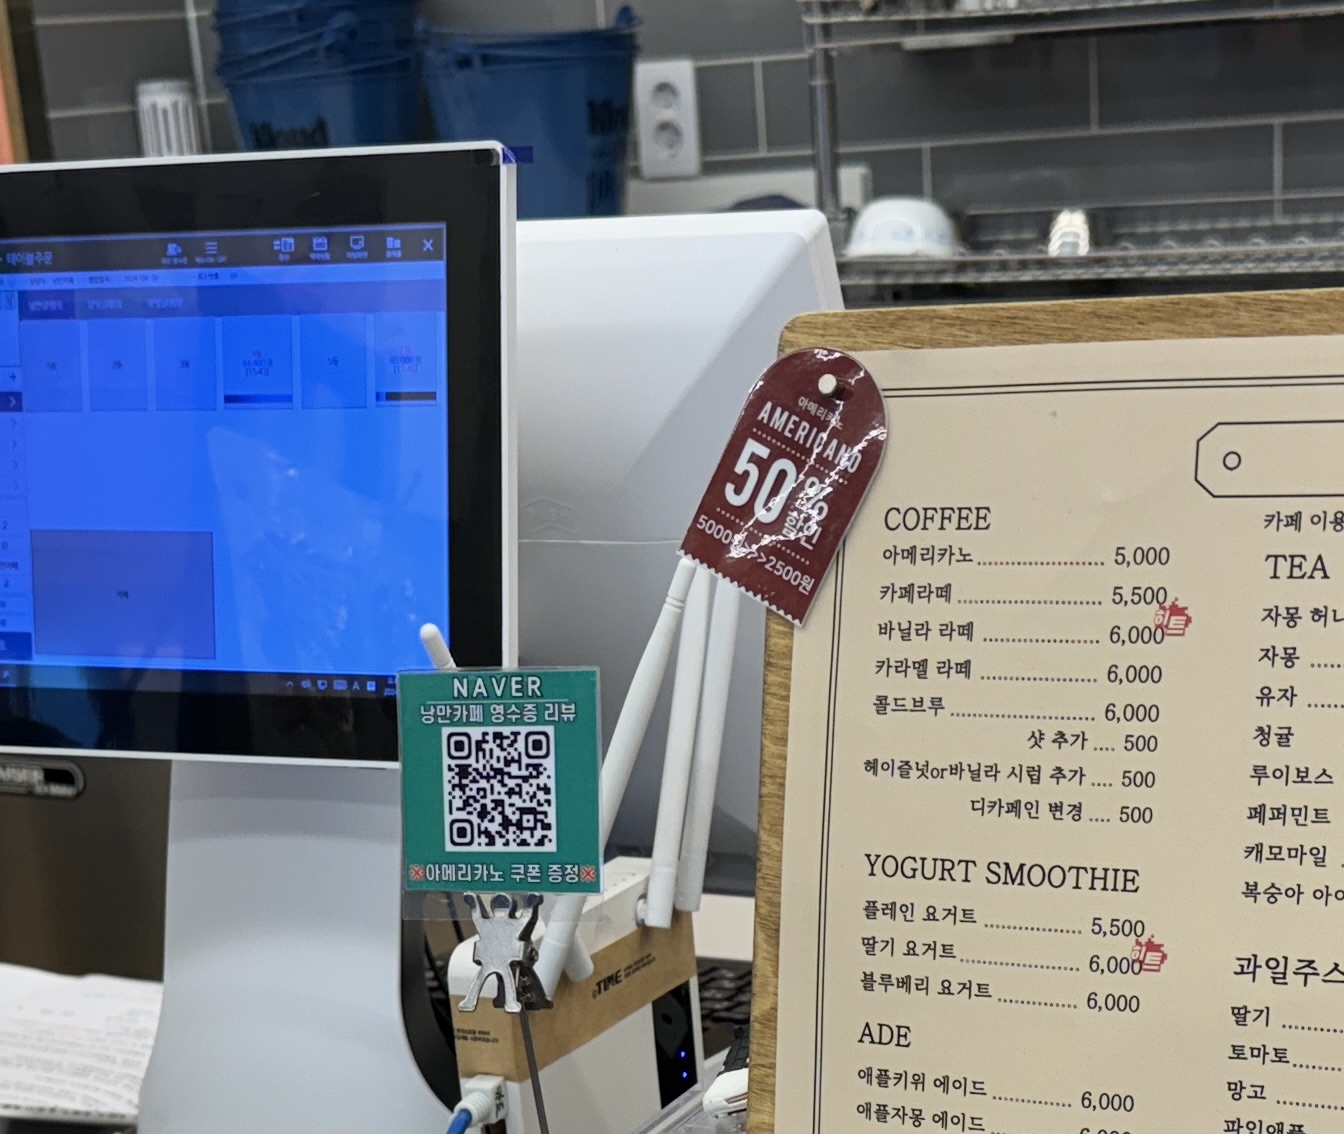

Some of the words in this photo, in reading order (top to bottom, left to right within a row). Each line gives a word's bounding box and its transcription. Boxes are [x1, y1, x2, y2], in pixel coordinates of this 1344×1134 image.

[758, 401, 862, 473] AMERICANO
[884, 506, 992, 532] COFFEE
[1263, 510, 1303, 533] 카페
[882, 544, 974, 567] 아메리카노
[1114, 546, 1171, 569] 5,000
[1264, 553, 1331, 580] TEA
[879, 582, 952, 605] 카페라떼
[1112, 587, 1167, 607] 5,500
[1260, 604, 1303, 629] 자몽
[877, 619, 933, 642] 바닐라
[938, 620, 974, 643] 라떼
[1110, 626, 1164, 646] 6,000
[1257, 644, 1301, 669] 자몽
[874, 657, 929, 680] 카라멜
[935, 658, 972, 681] 라떼
[1107, 663, 1163, 686] 6,000
[453, 676, 542, 698] NAVER
[1255, 685, 1298, 708] 유자
[421, 704, 483, 724] 낭만카페
[491, 703, 538, 723] 영수증
[544, 703, 576, 722] 리뷰
[872, 694, 946, 717] 콜드브루
[1104, 702, 1160, 724] 6,000
[1027, 728, 1045, 750] 샷
[1051, 730, 1089, 751] 추가
[1123, 734, 1158, 753] 500
[1252, 724, 1295, 748] 청귤
[863, 757, 1001, 783] 헤이즐넛or바닐라
[1006, 763, 1042, 785] 시럽
[1049, 765, 1087, 787] 추가
[1121, 769, 1156, 789] 500
[1249, 764, 1334, 787] 루이보스
[969, 796, 1040, 820] 디카페인
[1047, 800, 1083, 823] 변경
[1119, 805, 1154, 824] 500
[1246, 802, 1332, 827] 페퍼민트
[1243, 842, 1327, 868] 캐모마일
[511, 864, 541, 882] 쿠폰
[863, 853, 977, 883] YOGURT
[984, 860, 1140, 894] SMOOTHIE
[1241, 881, 1305, 906] 복숭아
[862, 899, 915, 923] 플레인
[921, 905, 977, 927] 요거트
[1091, 916, 1146, 938] 5,500
[861, 935, 895, 958] 딸기
[902, 940, 957, 961] 요거트
[1089, 955, 1142, 975] 6,000
[859, 970, 930, 997] 블루베리
[937, 978, 993, 1000] 요거트
[1086, 991, 1141, 1014] 6,000
[1230, 1004, 1270, 1028] 딸기
[857, 1021, 912, 1048] ADE
[1227, 1043, 1290, 1066] 토마토
[857, 1066, 926, 1093] 애플키위
[933, 1074, 988, 1098] 에이드
[1080, 1090, 1135, 1113] 6,000
[1226, 1079, 1267, 1102] 망고
[856, 1101, 926, 1128] 애플자몽
[931, 1110, 986, 1133] 에이드
